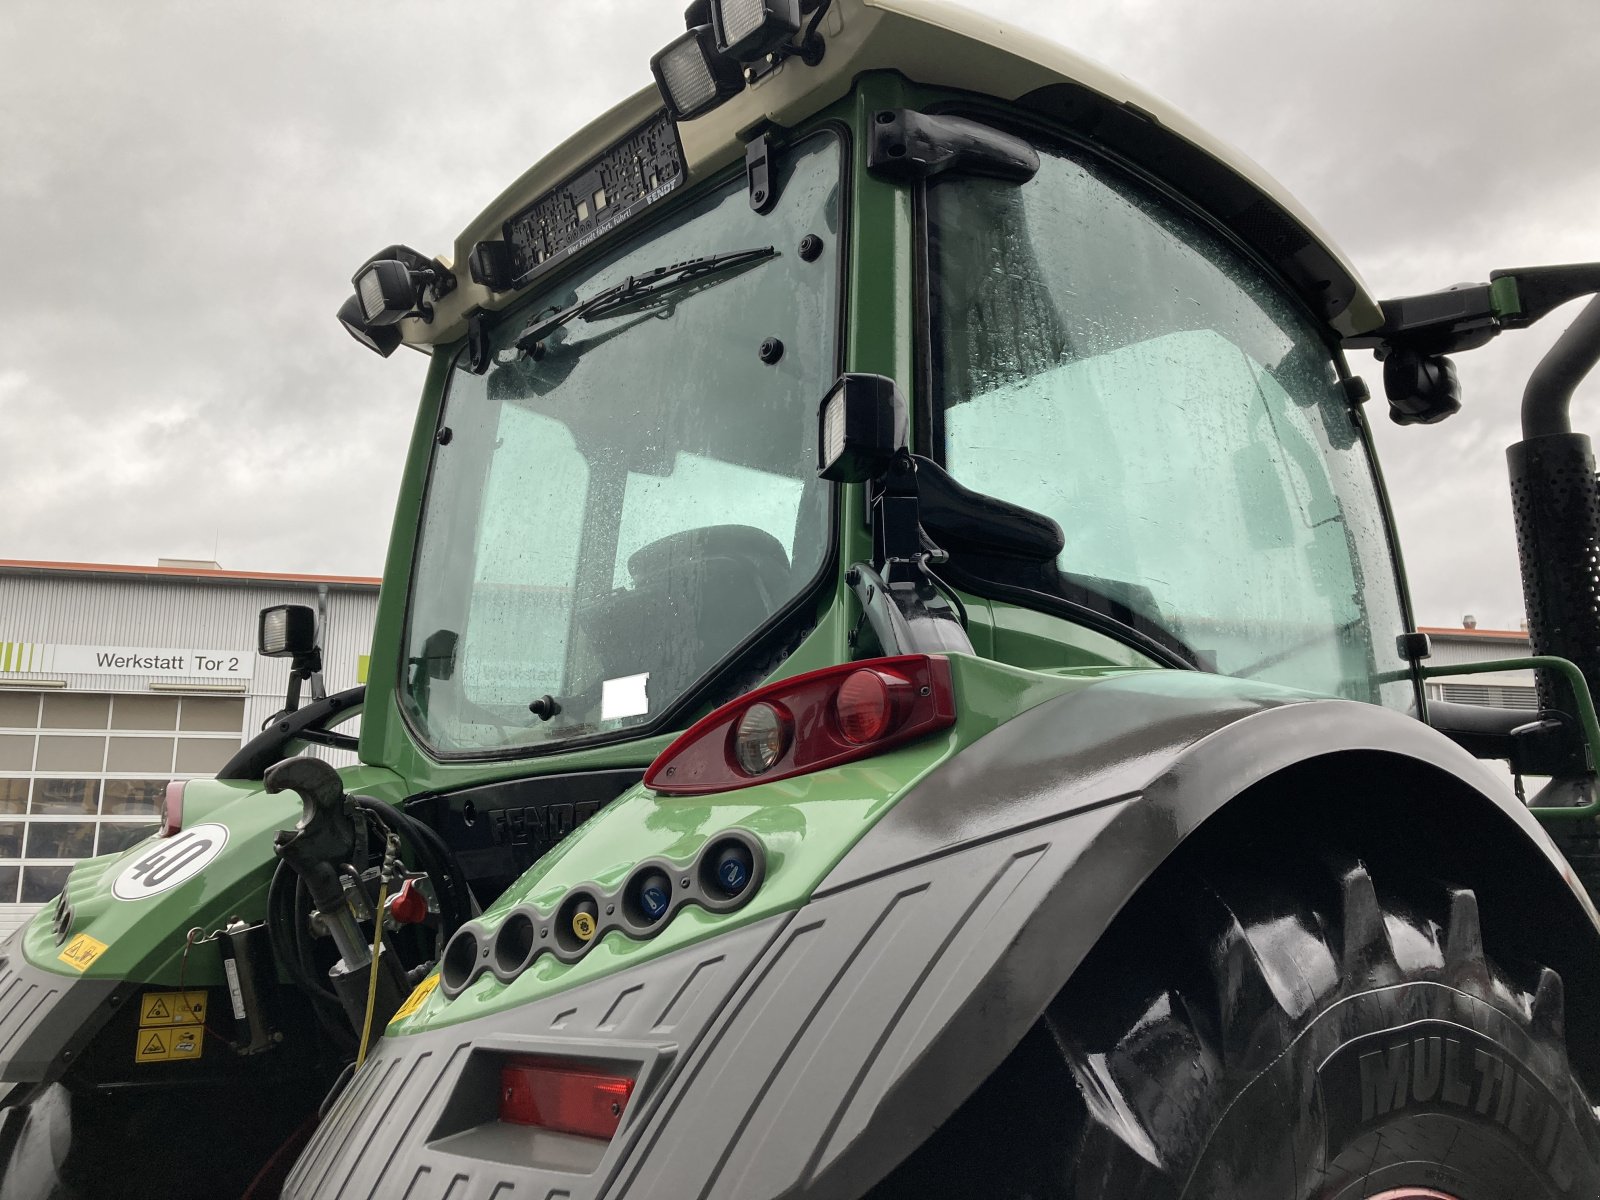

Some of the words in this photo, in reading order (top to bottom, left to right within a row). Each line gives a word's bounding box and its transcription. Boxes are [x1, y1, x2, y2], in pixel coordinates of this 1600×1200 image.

[646, 179, 676, 205] FENDT
[579, 232, 596, 247] Fendt
[96, 652, 184, 670] Werkstatt
[194, 655, 223, 671] Tor
[228, 657, 239, 671] 2
[130, 832, 213, 888] 40
